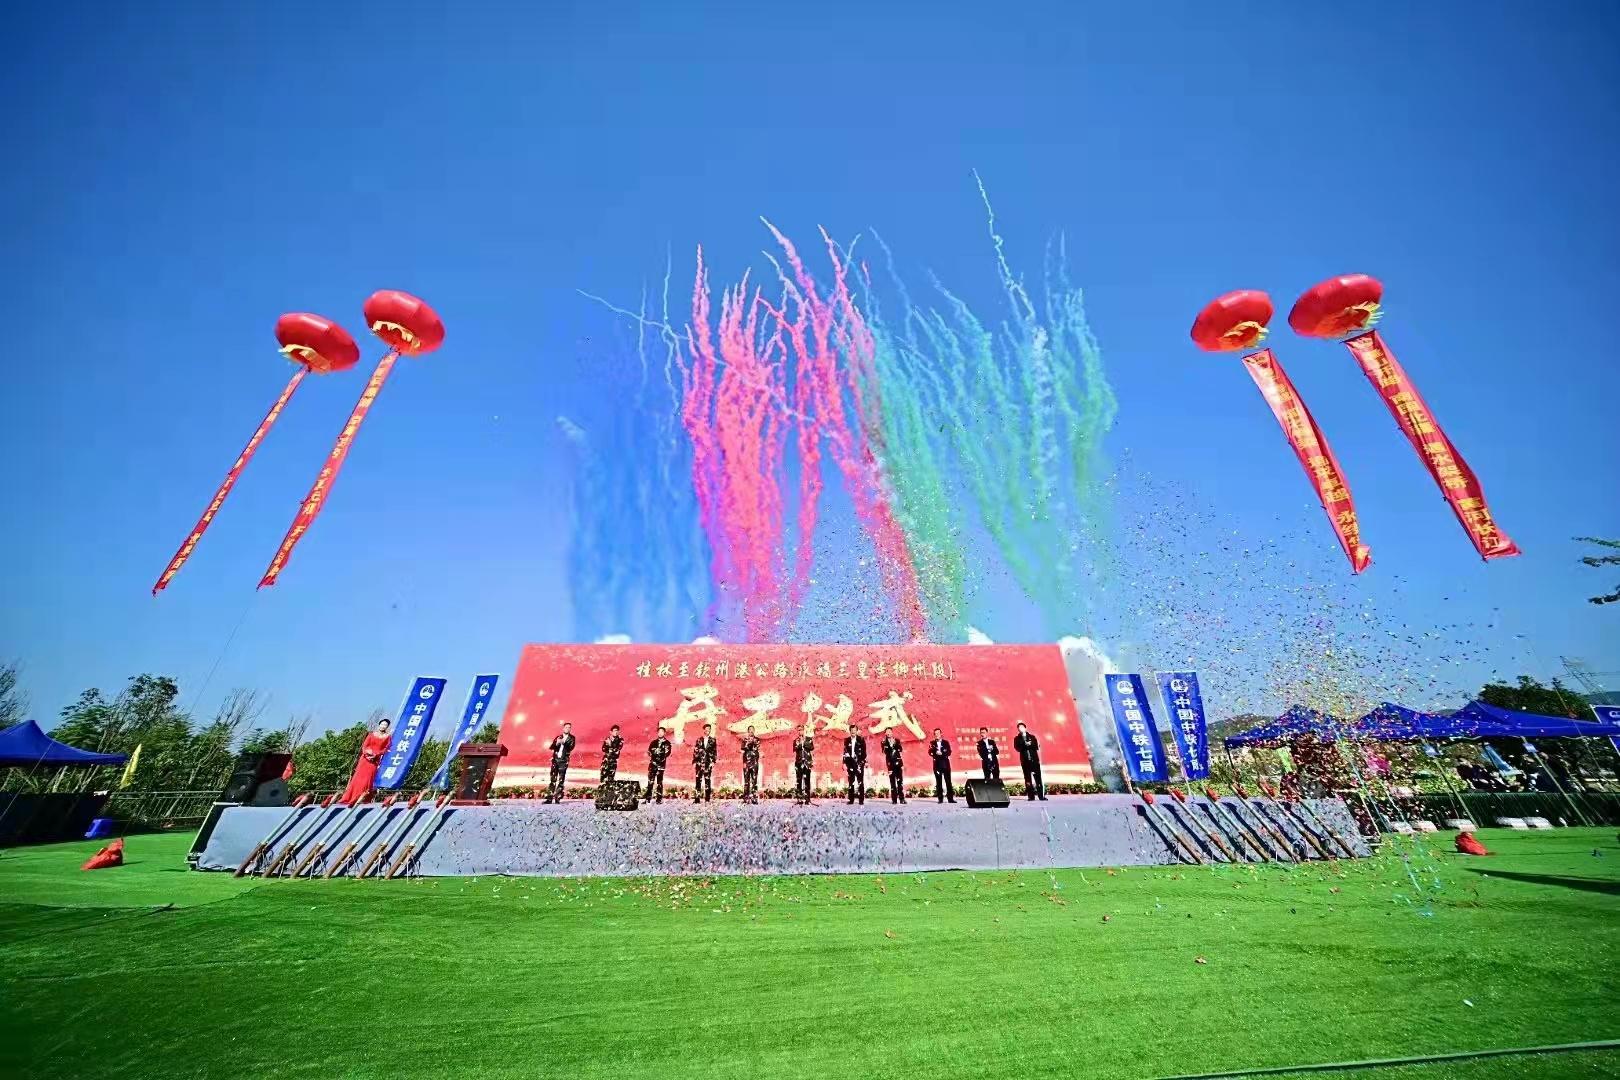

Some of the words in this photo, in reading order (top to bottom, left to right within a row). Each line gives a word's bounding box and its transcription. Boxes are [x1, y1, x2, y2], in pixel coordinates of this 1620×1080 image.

[381, 702, 428, 779] 中国中铁七局
[658, 682, 927, 745] 开工仪式
[1122, 697, 1156, 773] 中国中铁七局
[1174, 696, 1202, 771] 中国中铁七局
